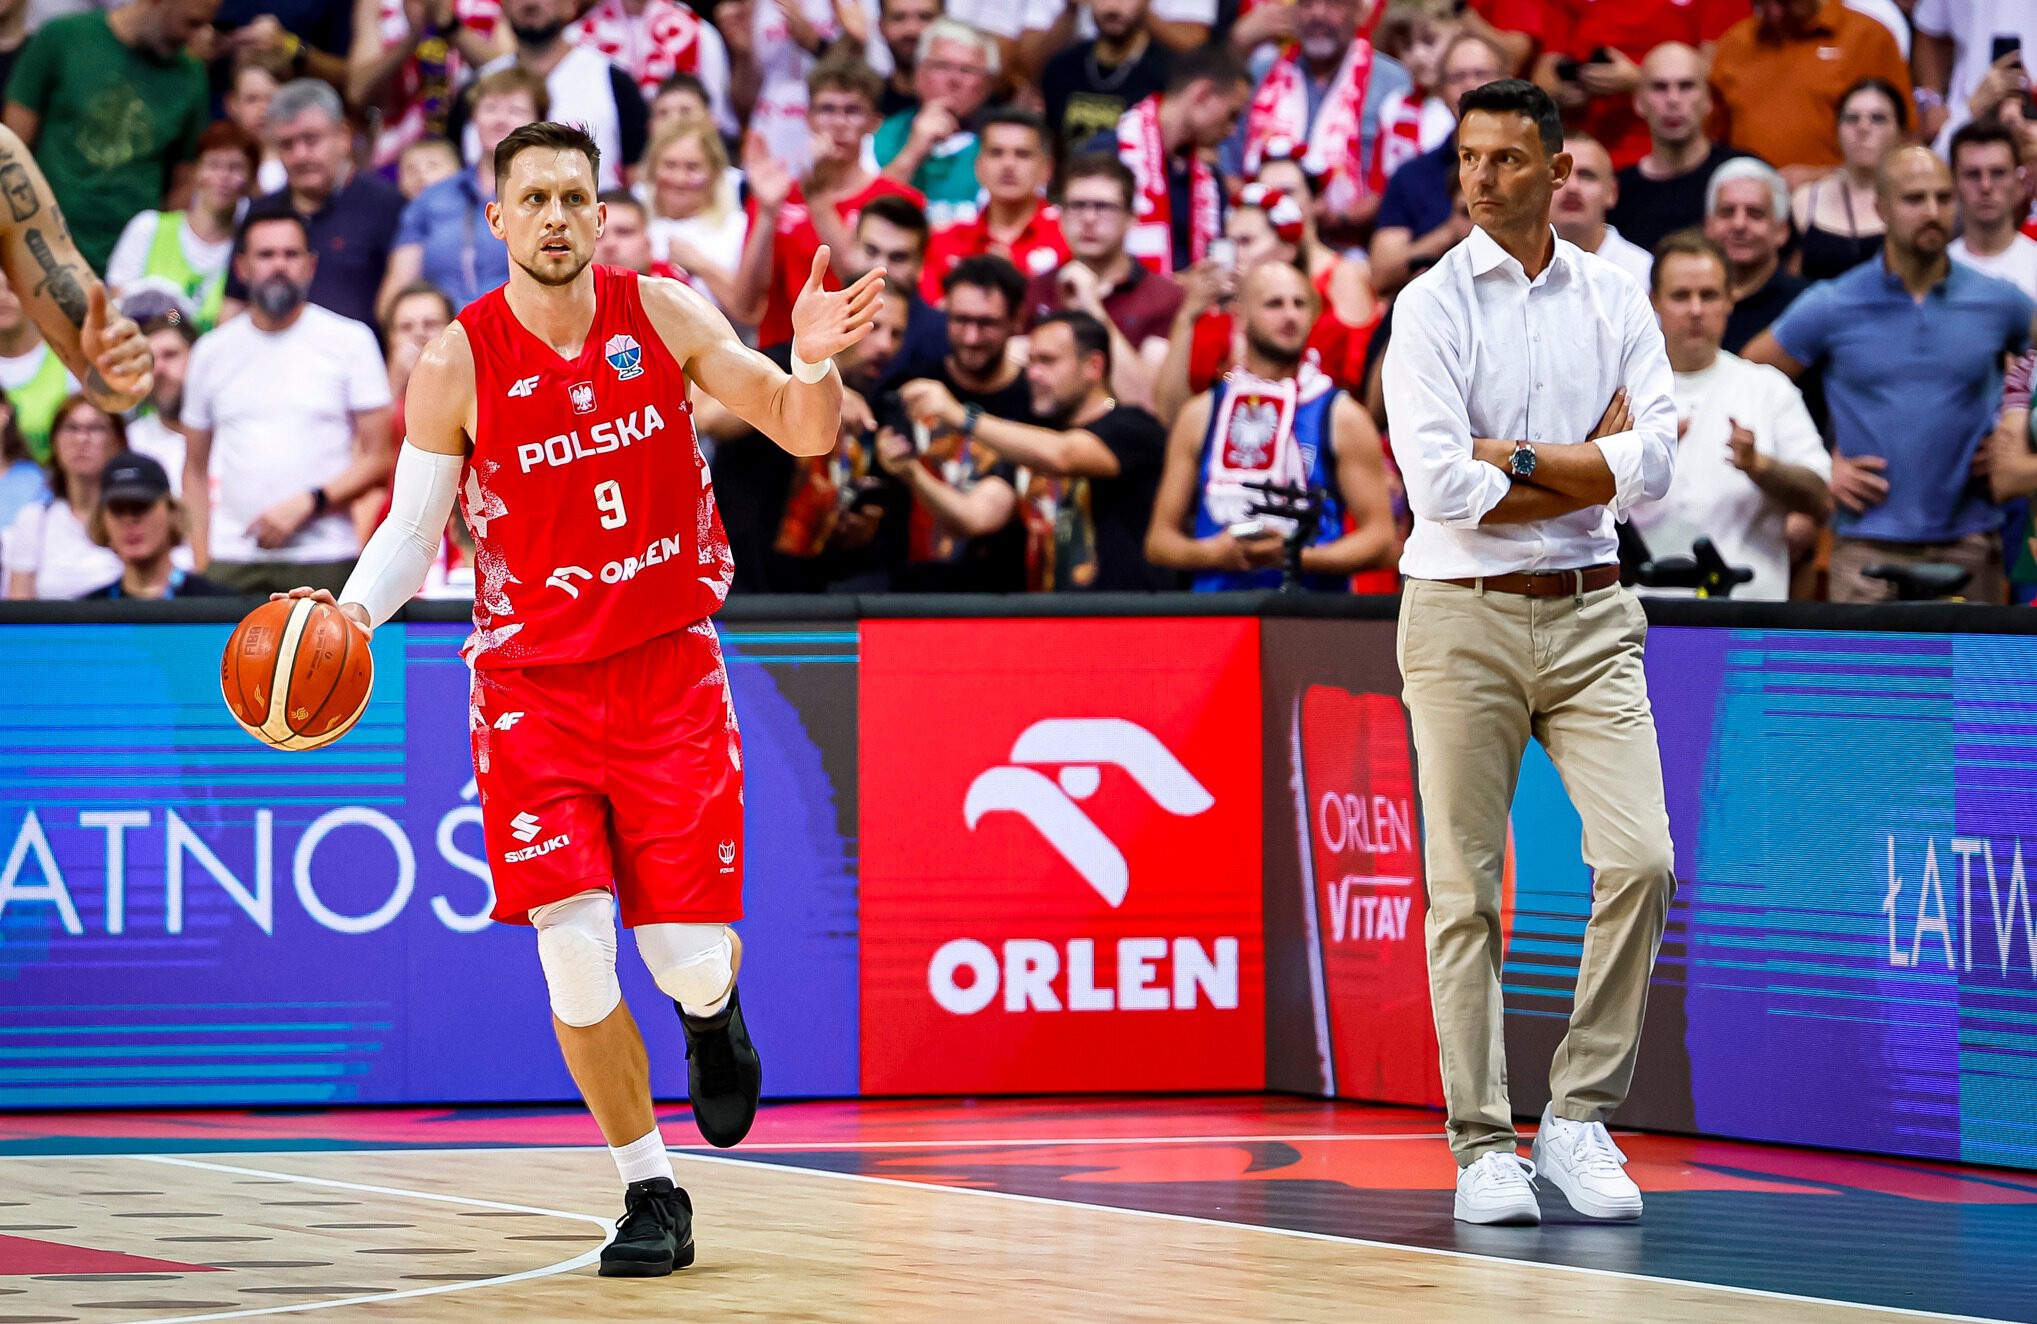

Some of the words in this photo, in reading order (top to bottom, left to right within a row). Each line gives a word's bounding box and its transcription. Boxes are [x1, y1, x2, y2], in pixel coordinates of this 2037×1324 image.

[507, 375, 540, 397] 4F
[517, 404, 665, 474] POLSKA
[593, 479, 628, 530] 9
[600, 533, 680, 584] ORLEN
[244, 626, 261, 656] FIBA
[493, 711, 525, 731] 4F
[1319, 790, 1413, 854] ORLEN
[504, 834, 571, 864] SUZUKI
[1327, 874, 1415, 944] VITAY
[1882, 833, 2037, 981] ŁATW
[927, 936, 1239, 1016] ORLEN
